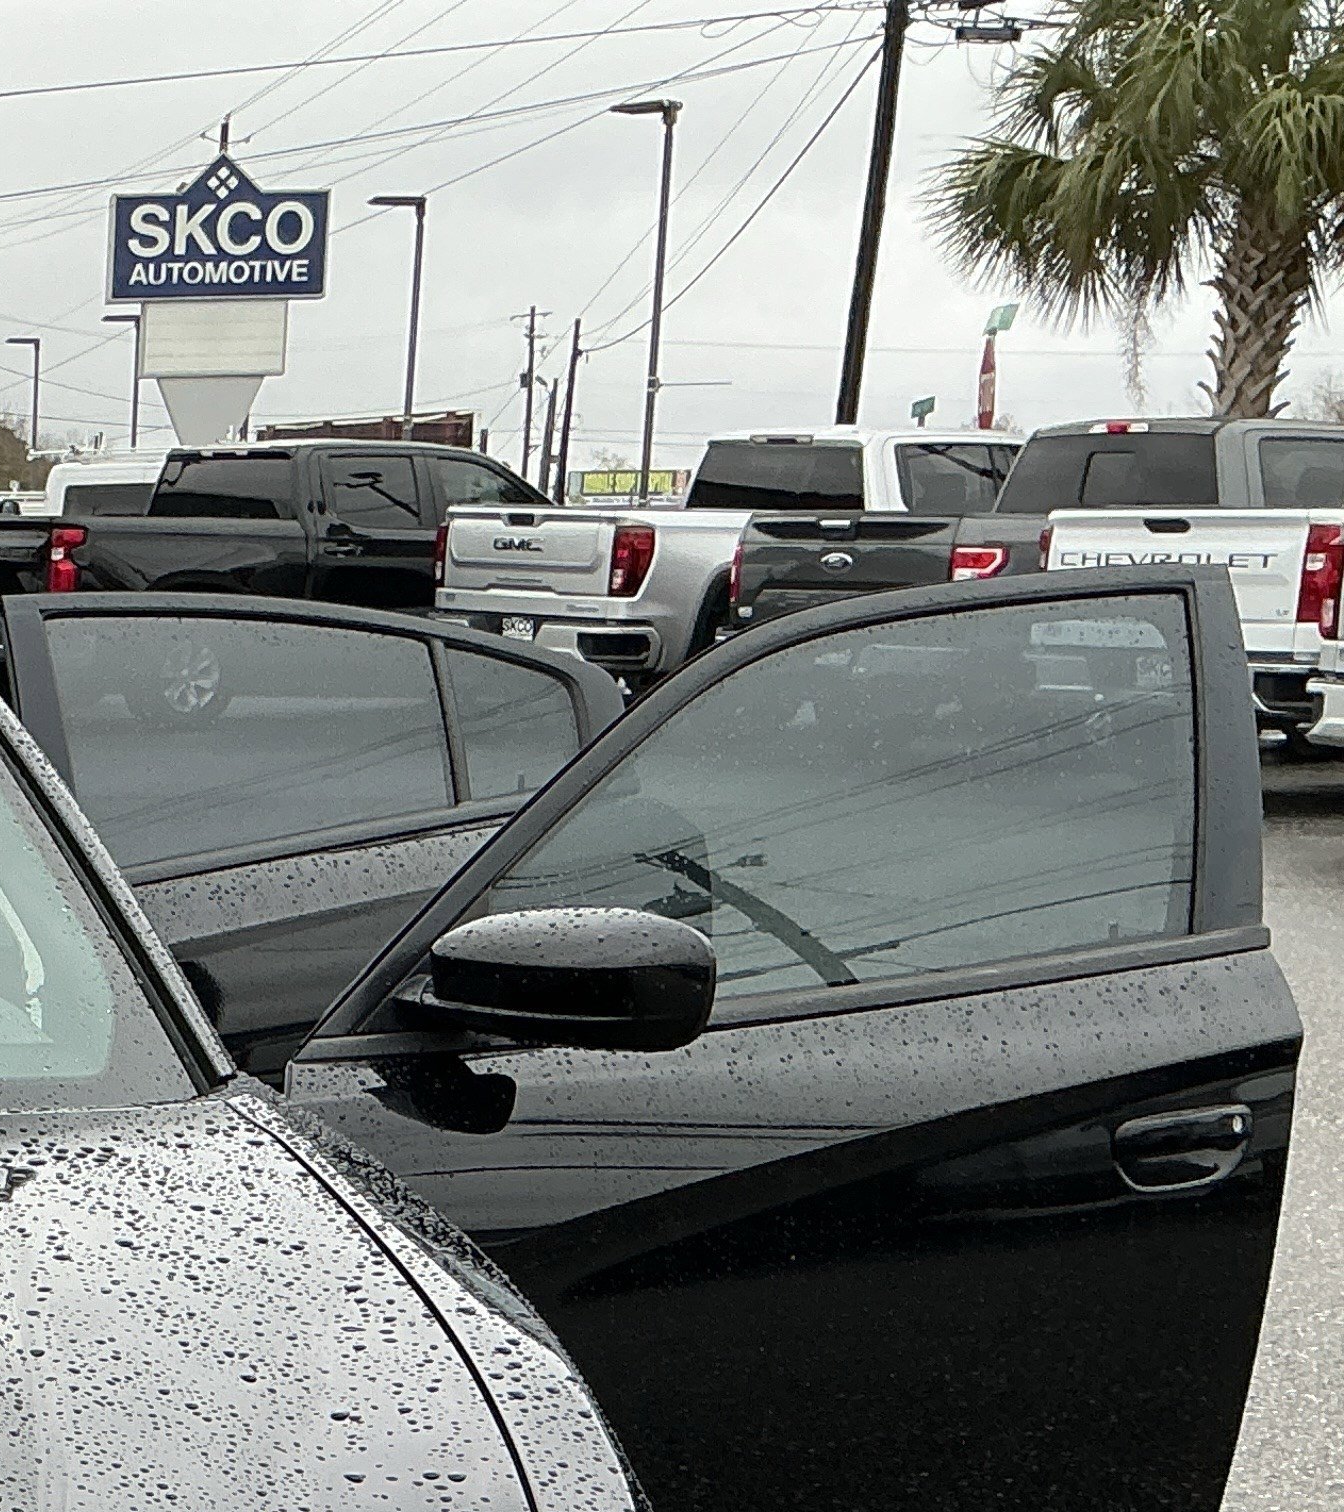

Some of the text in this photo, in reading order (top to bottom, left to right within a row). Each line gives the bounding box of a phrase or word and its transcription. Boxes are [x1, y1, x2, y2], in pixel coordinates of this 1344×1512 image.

[127, 200, 315, 258] SKCO
[128, 259, 310, 286] AUTOMOTIVE
[493, 537, 544, 552] GMC
[1060, 552, 1279, 569] CHEVROLET
[503, 618, 533, 632] SKCO
